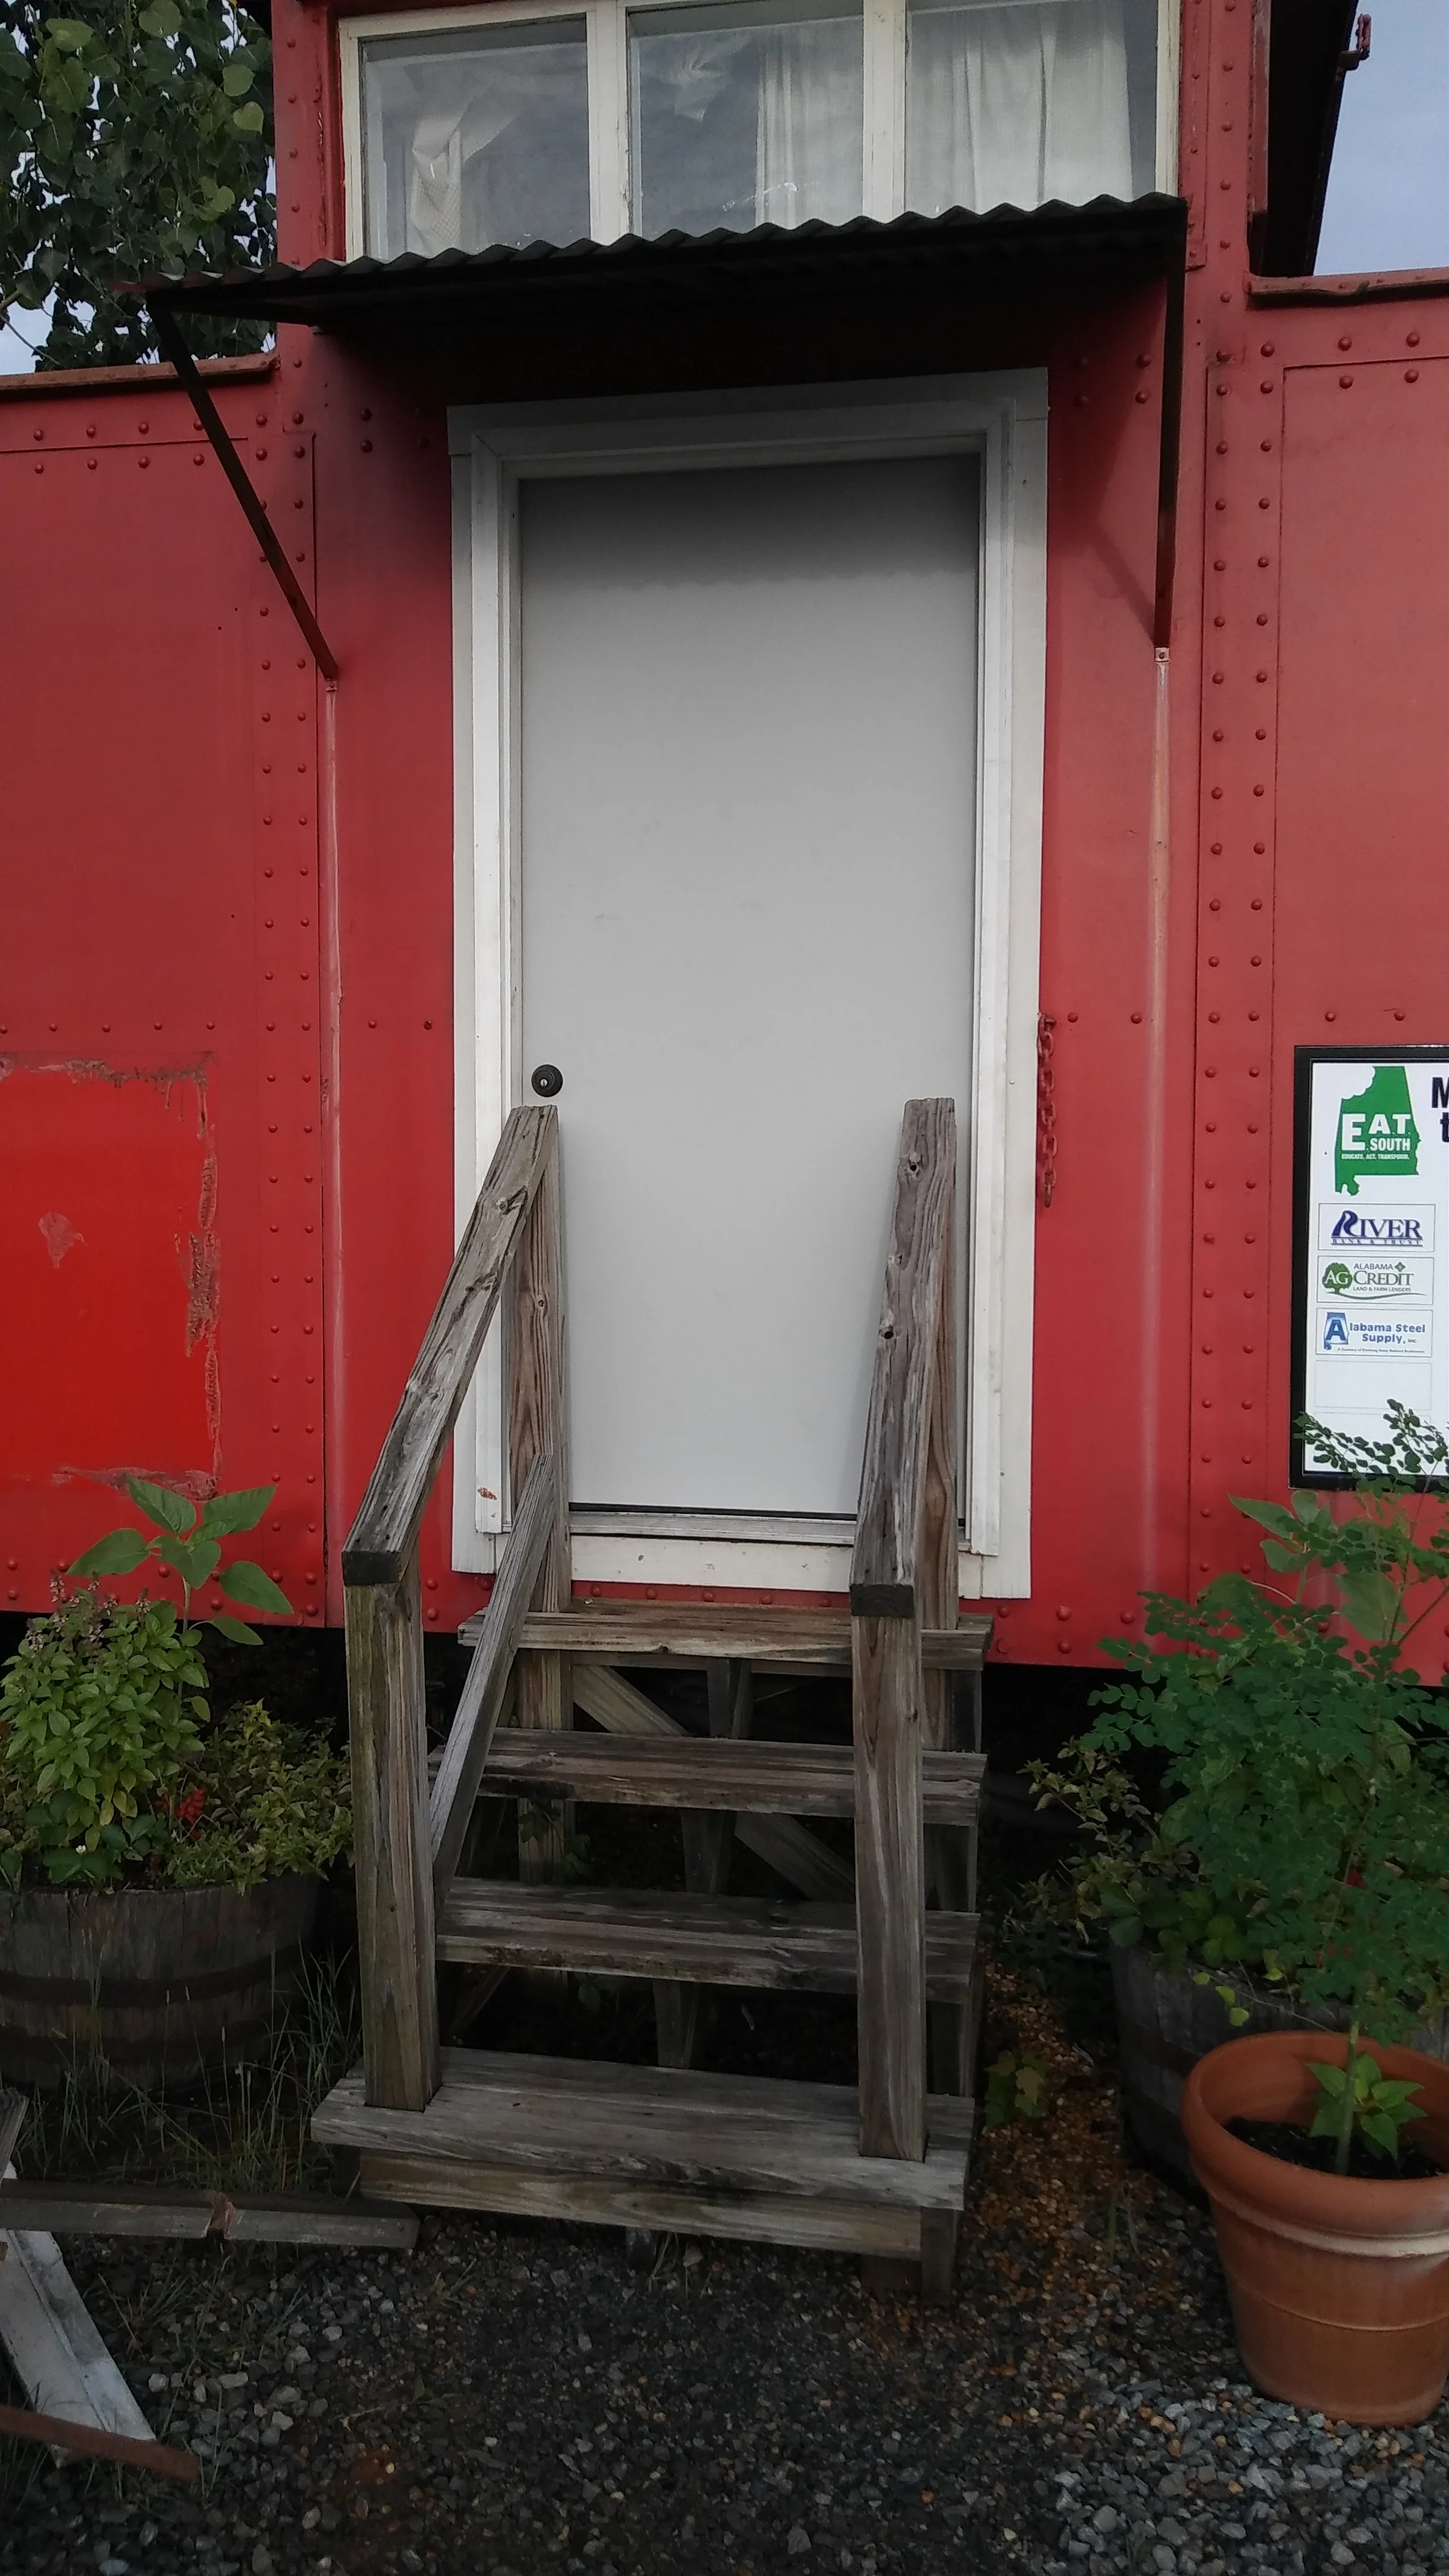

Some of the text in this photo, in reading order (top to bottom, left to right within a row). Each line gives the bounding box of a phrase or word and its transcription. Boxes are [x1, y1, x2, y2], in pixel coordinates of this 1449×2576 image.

[1370, 1138, 1410, 1151] SOUTH
[1331, 1210, 1423, 1238] RIVER
[1324, 1269, 1414, 1286] AG CREDIT
[1395, 1324, 1425, 1333] Steel
[1362, 1334, 1406, 1344] Supply,
